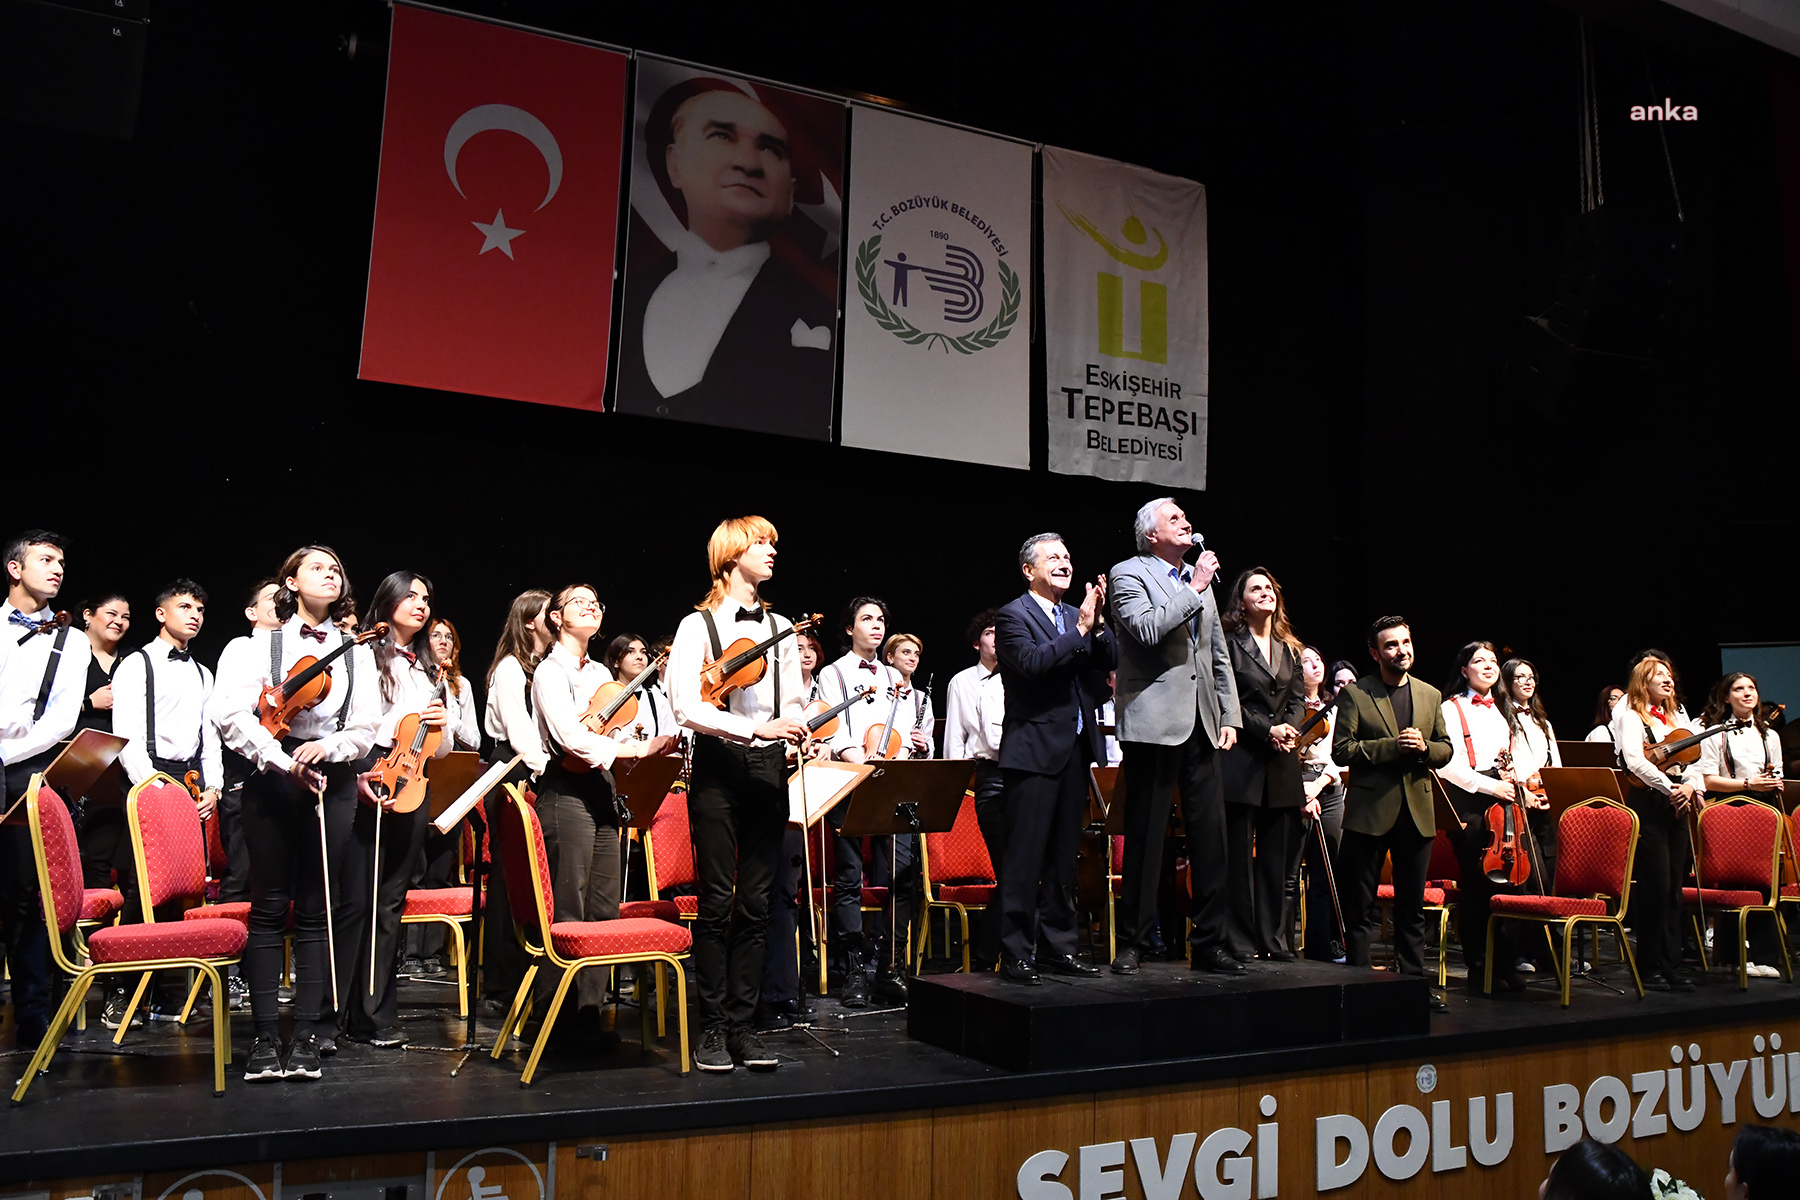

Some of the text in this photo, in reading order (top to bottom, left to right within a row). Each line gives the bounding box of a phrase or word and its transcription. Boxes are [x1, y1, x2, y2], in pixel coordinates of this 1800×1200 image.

[872, 195, 1009, 257] T.C. BOZÜYÜK BELEDİYESİ
[929, 230, 950, 241] 1890
[1086, 363, 1182, 400] ESKİŞEHİR
[1061, 386, 1197, 441] TEPEBAŞI
[1087, 429, 1183, 462] BELEDİYESİ
[1017, 1094, 1279, 1200] SEVGİ
[1316, 1092, 1515, 1192] DOLU
